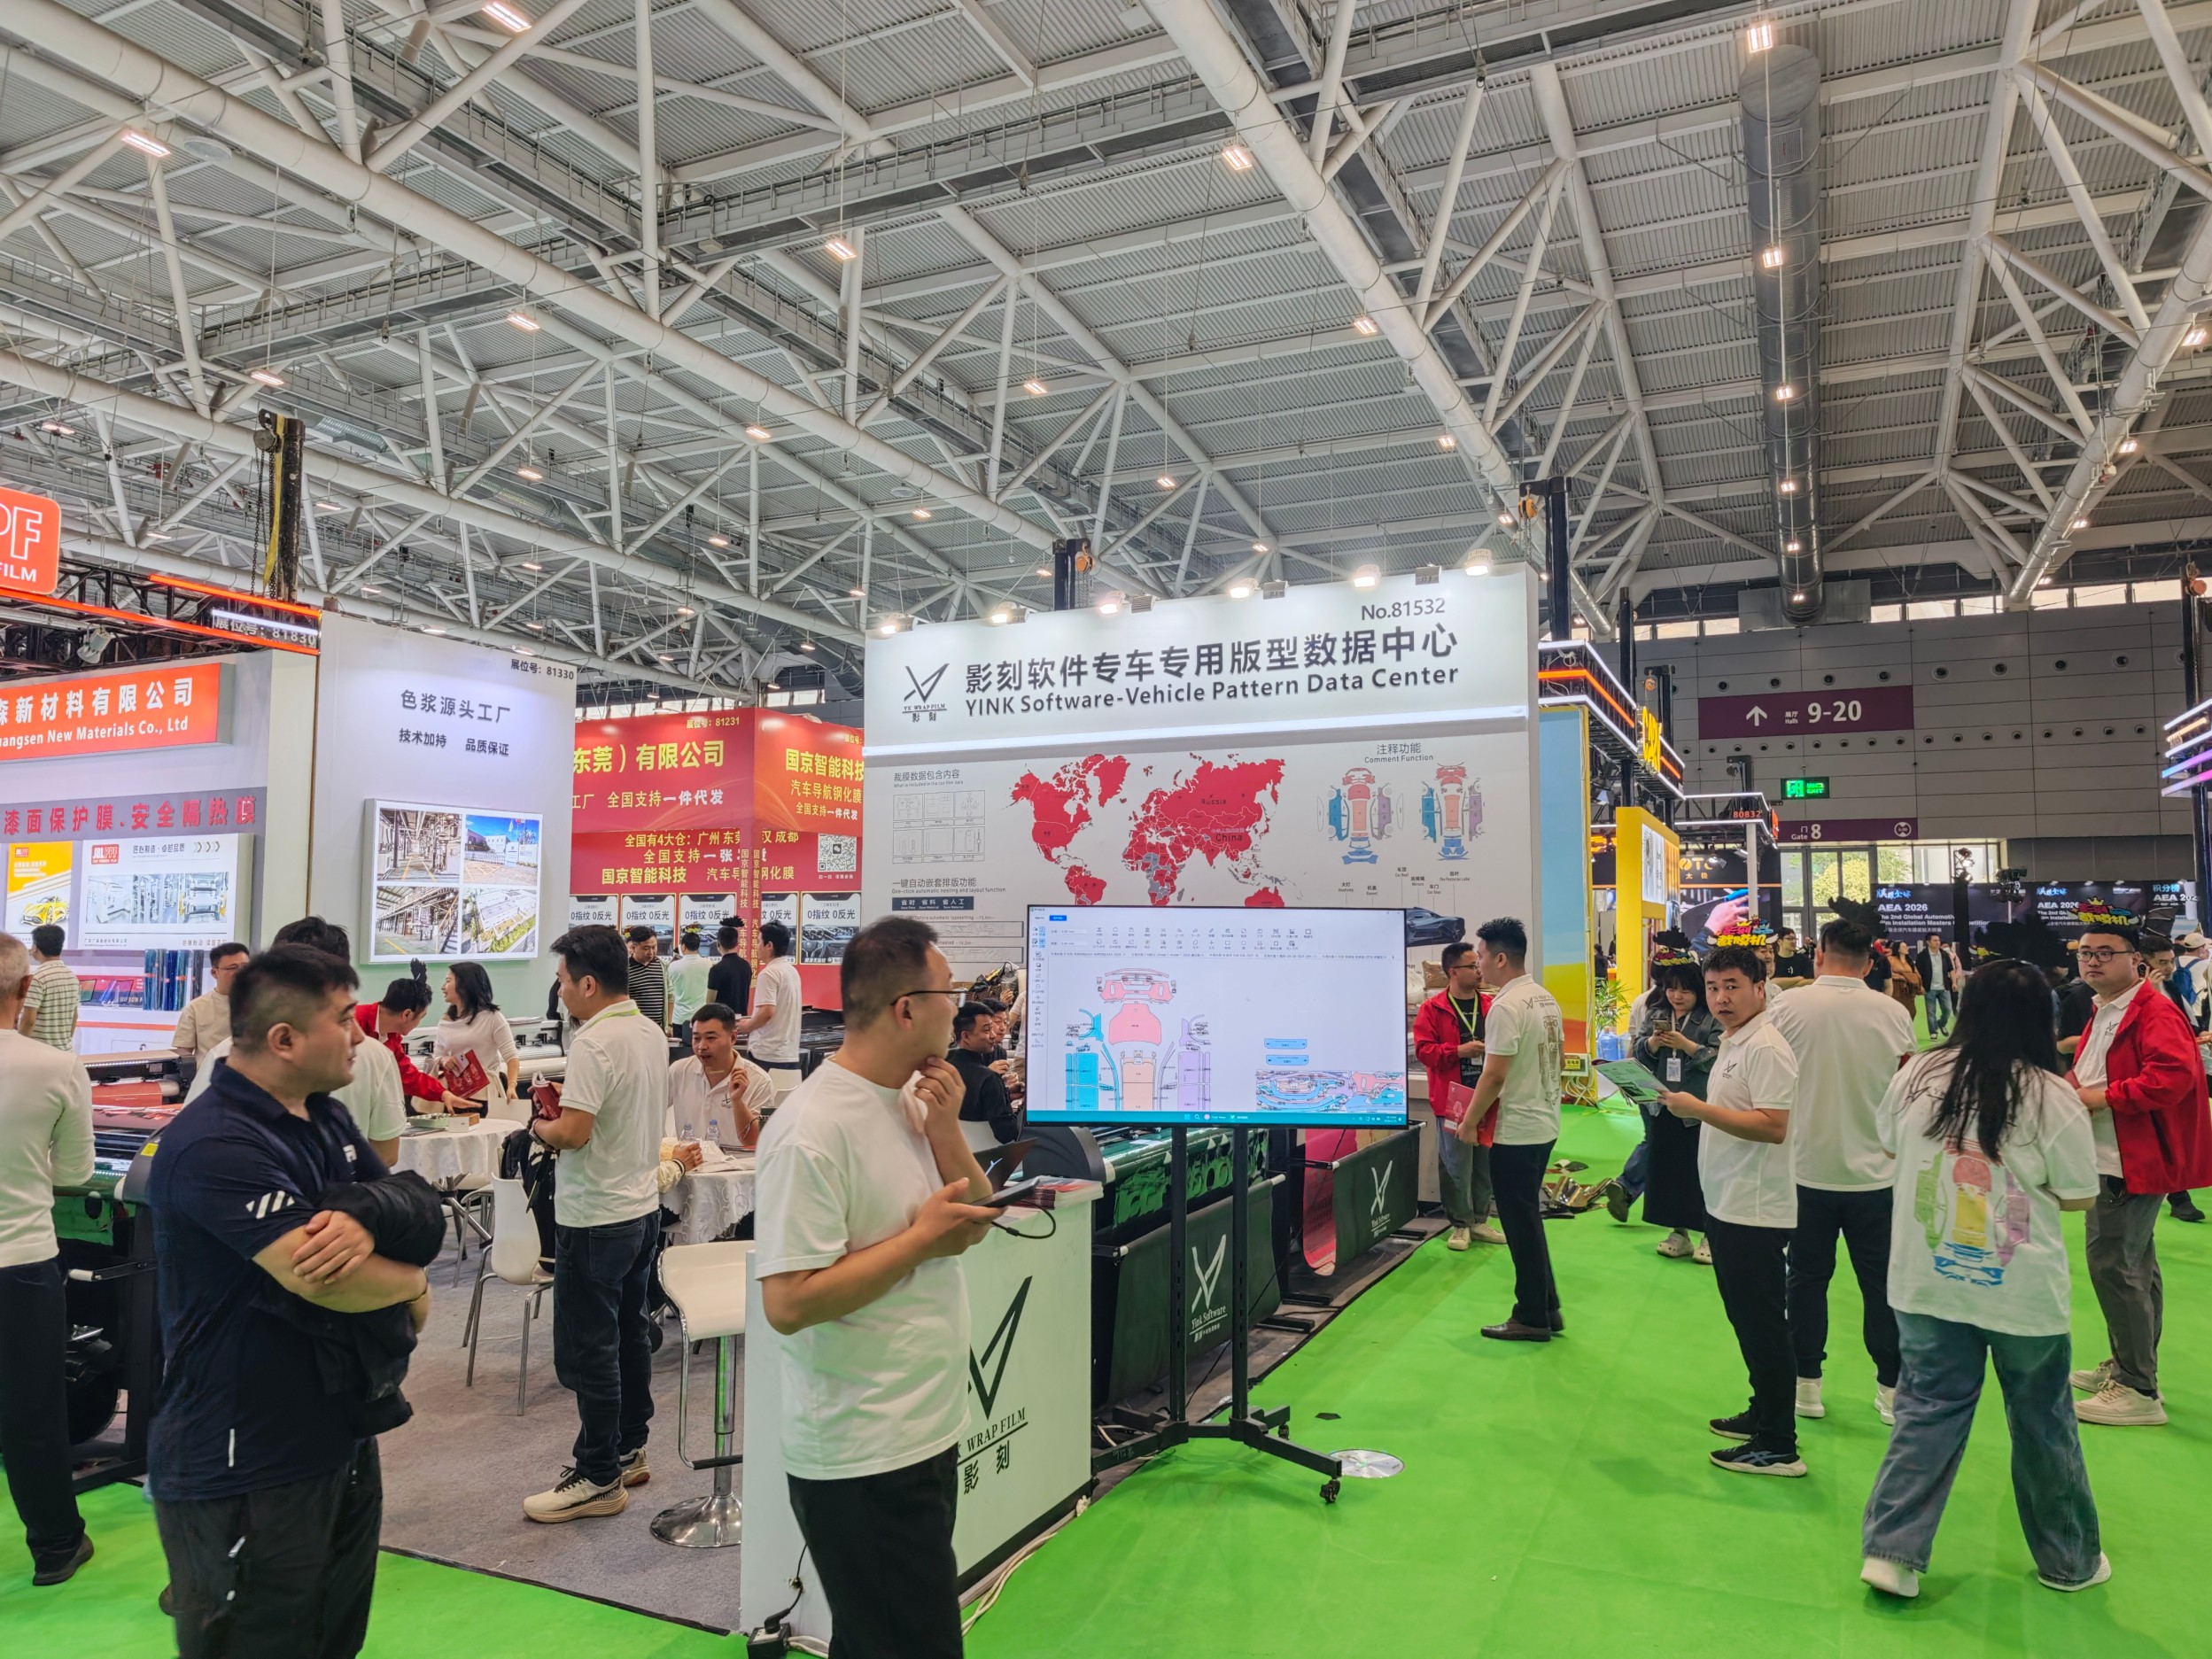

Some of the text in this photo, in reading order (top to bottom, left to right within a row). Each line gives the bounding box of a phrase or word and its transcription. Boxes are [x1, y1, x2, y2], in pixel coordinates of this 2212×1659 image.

[0, 562, 37, 583] ILM
[1361, 597, 1446, 620] No.81532
[966, 623, 1458, 694] 影刻软件专车专用版型数据中心
[966, 666, 1459, 717] YINK Software-Vehicle Pattern Data Center
[400, 688, 511, 724] 色浆源头工厂
[1807, 700, 1862, 724] 9-20
[47, 729, 73, 743] New
[76, 721, 135, 740] Materials
[138, 720, 163, 735] Co.,
[167, 715, 189, 732] Ltd
[399, 728, 509, 756] 技术加持 品质保证
[1377, 742, 1422, 756] 注释功能
[786, 748, 865, 782] 国京智能科技
[608, 789, 724, 809] 全国支持一件代发
[790, 779, 862, 804] 汽车导航钢化膜
[796, 802, 858, 820] 全国支持一件代发
[1733, 810, 1762, 818] 80832
[775, 831, 799, 844] 成都
[1215, 833, 1243, 842] China
[1811, 823, 1821, 840] 8
[602, 866, 687, 885] 国京智能科技
[892, 877, 977, 888] 一键自动嵌套排版功能
[2153, 883, 2180, 893] 积分榜
[1203, 1305, 1227, 1322] Software
[966, 1423, 998, 1453] WRAP
[1000, 1407, 1026, 1434] FILM
